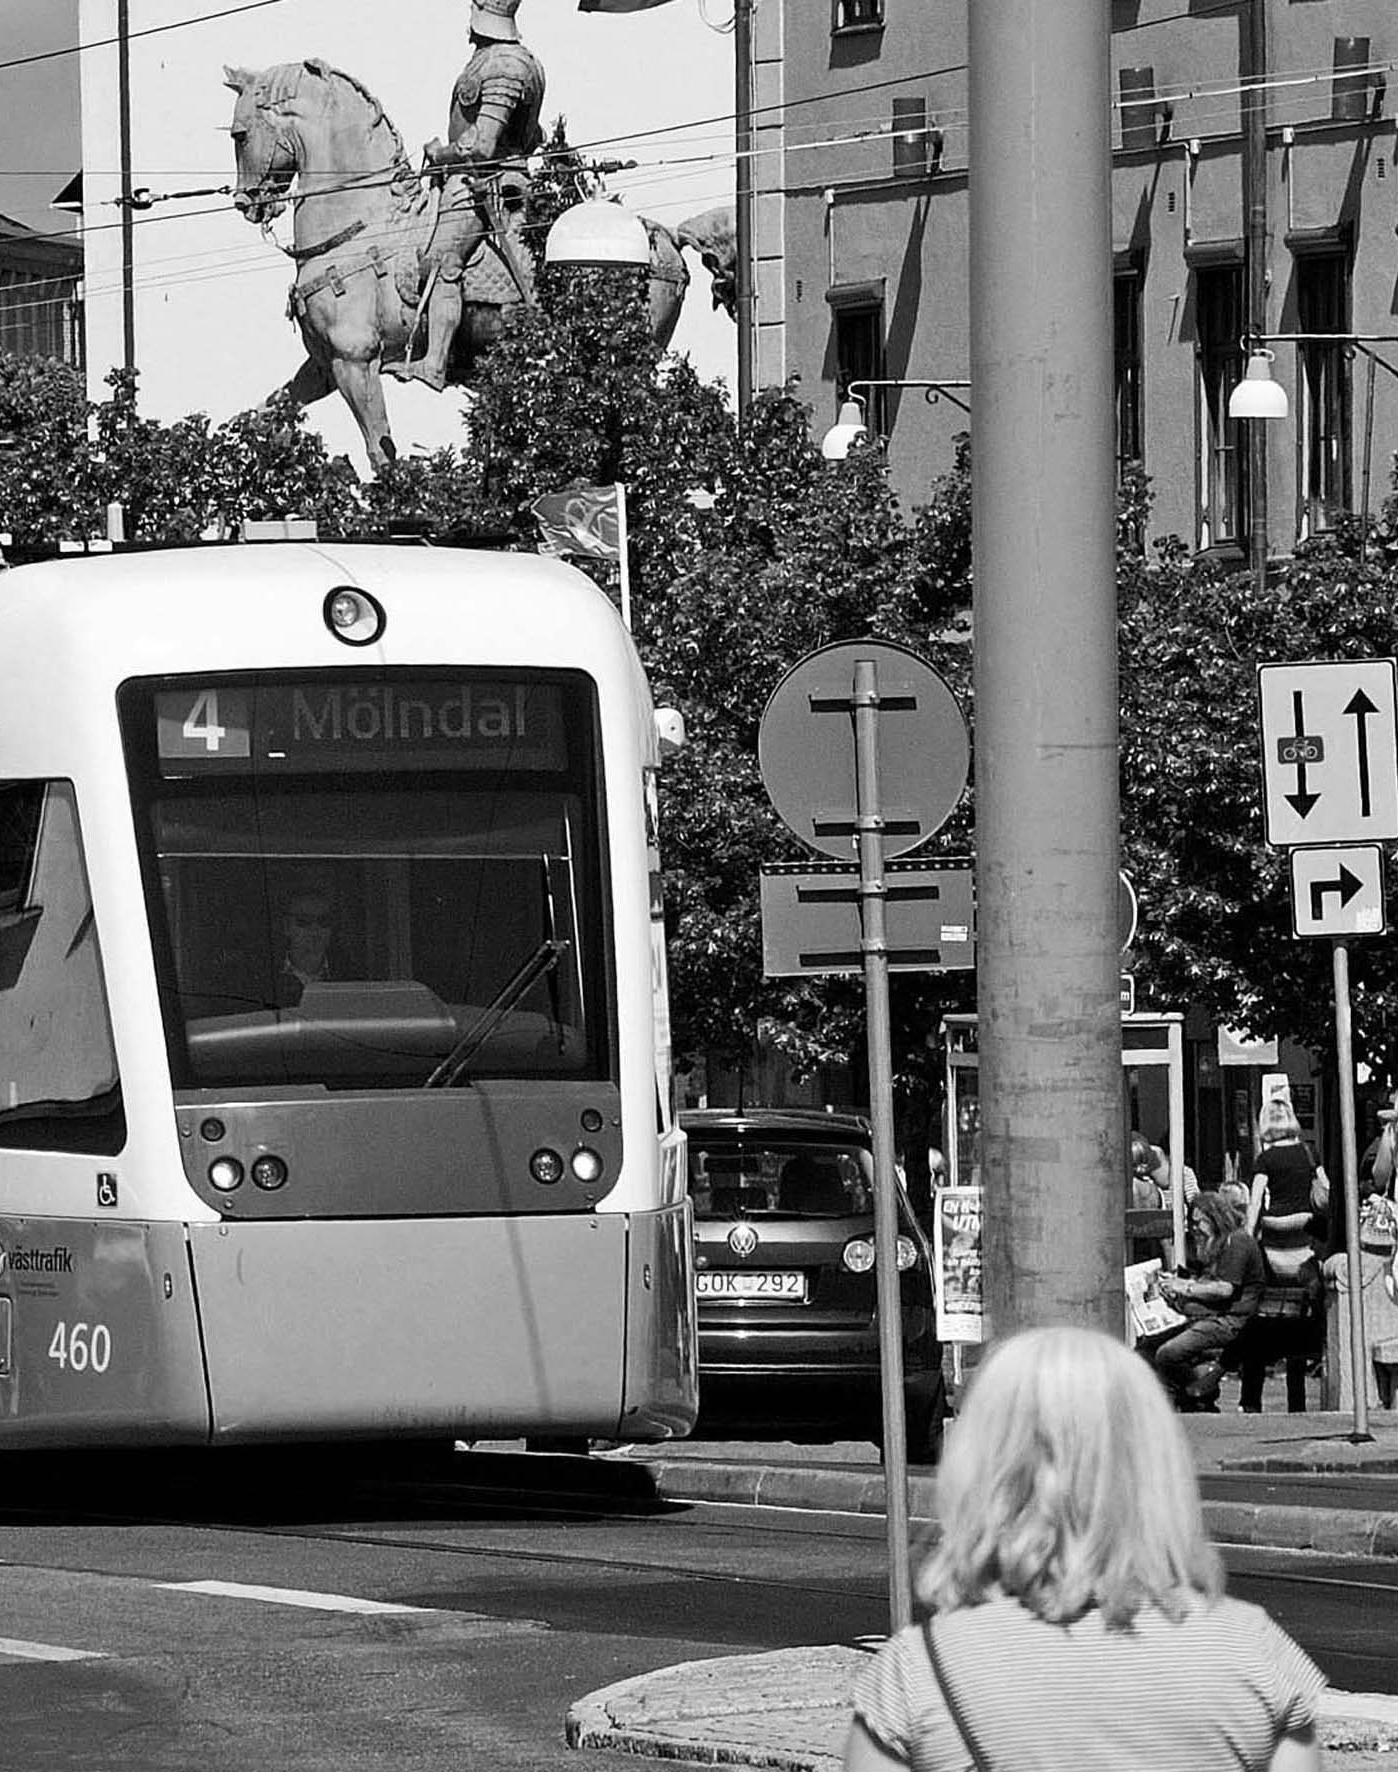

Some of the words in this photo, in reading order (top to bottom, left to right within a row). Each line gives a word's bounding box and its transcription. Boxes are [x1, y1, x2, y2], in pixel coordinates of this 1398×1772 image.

[181, 689, 227, 752] 4
[292, 686, 526, 741] Mölndal
[8, 1245, 73, 1273] västtrafik
[696, 1273, 738, 1293] GOK
[756, 1273, 799, 1293] 292
[47, 1320, 112, 1374] 460
